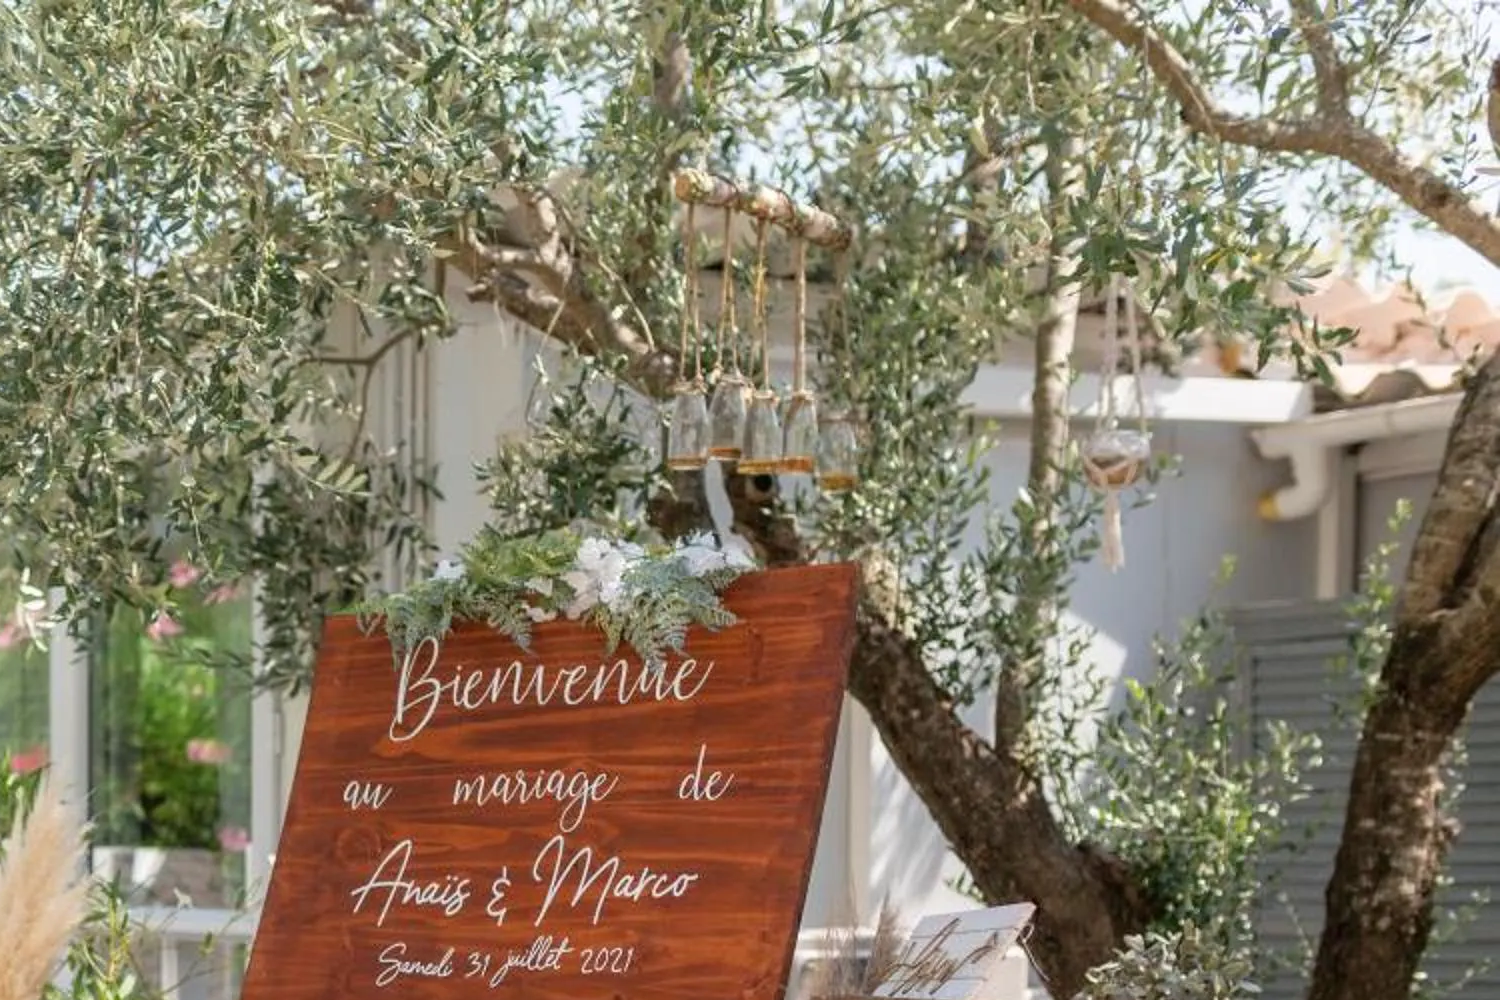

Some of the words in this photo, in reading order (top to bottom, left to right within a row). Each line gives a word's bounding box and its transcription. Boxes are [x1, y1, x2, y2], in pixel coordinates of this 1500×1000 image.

[390, 635, 714, 742] Bienvenue
[343, 779, 392, 810] au
[453, 770, 619, 833] mariage
[679, 743, 734, 801] de
[350, 839, 471, 926] Anaïs
[485, 866, 511, 926] &
[532, 834, 700, 927] Marco
[376, 942, 455, 987] Samedi
[465, 952, 491, 978] 31
[490, 935, 574, 988] juillet
[581, 947, 635, 975] 2021
